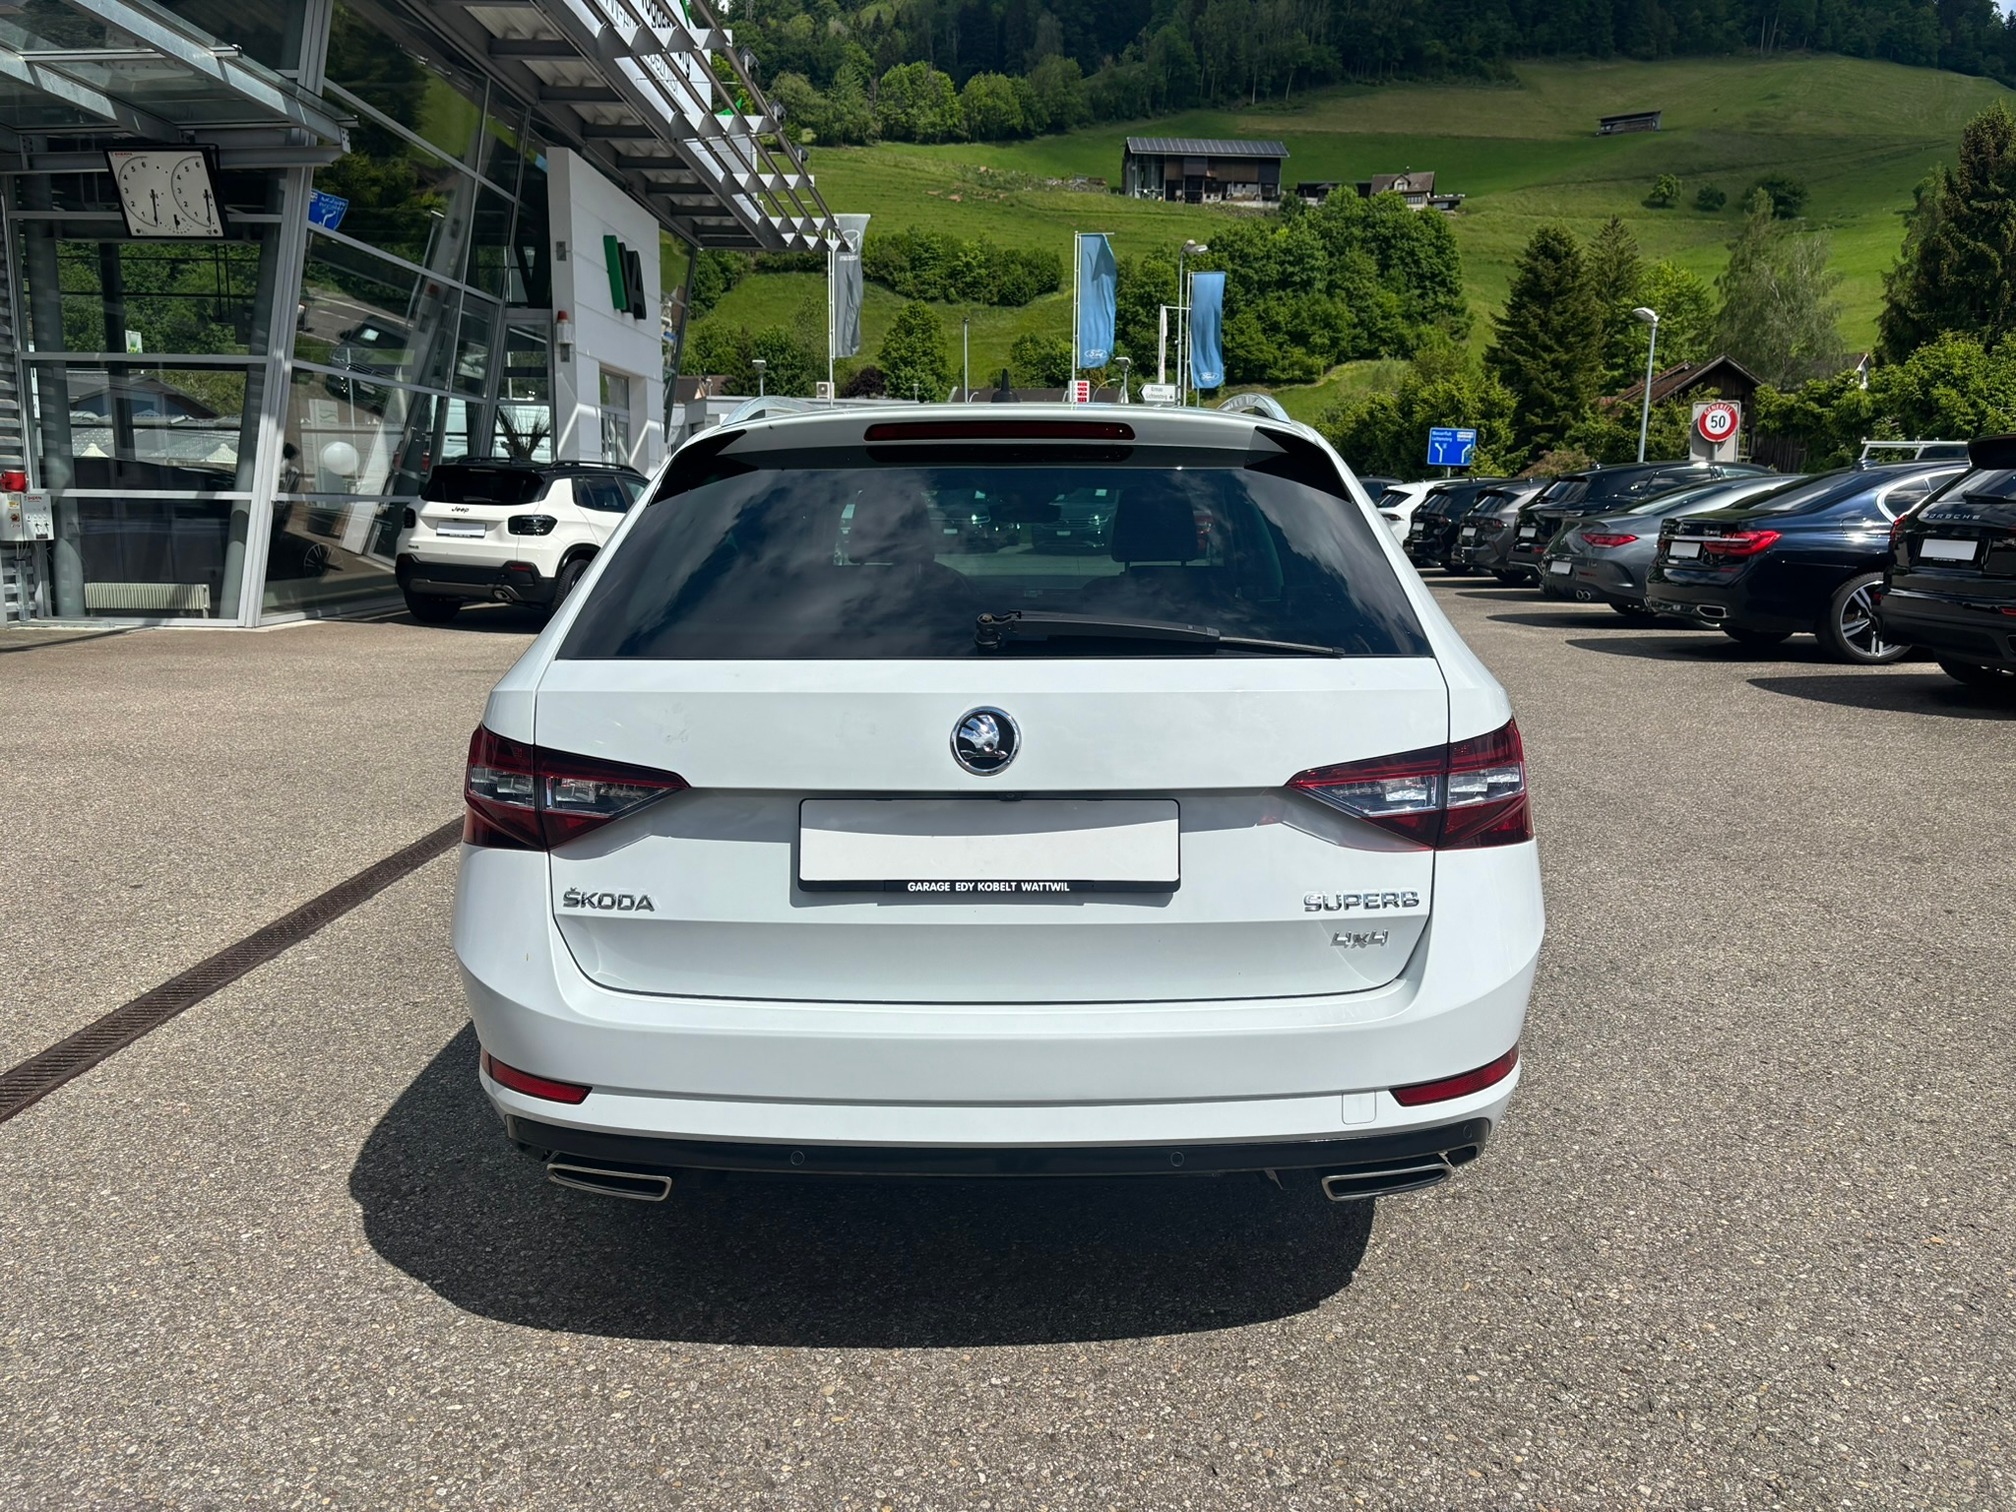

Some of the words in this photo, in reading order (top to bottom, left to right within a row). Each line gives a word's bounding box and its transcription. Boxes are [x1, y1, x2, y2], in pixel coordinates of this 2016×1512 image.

[1711, 415, 1726, 428] 50
[1922, 512, 1980, 520] PORSCHE
[907, 882, 951, 892] GARAGE
[955, 882, 975, 892] EDY
[977, 882, 1017, 892] KOBELT
[1021, 882, 1070, 892] WATTWIL
[563, 887, 655, 912] ŠKODA
[1303, 891, 1420, 912] SUPERB
